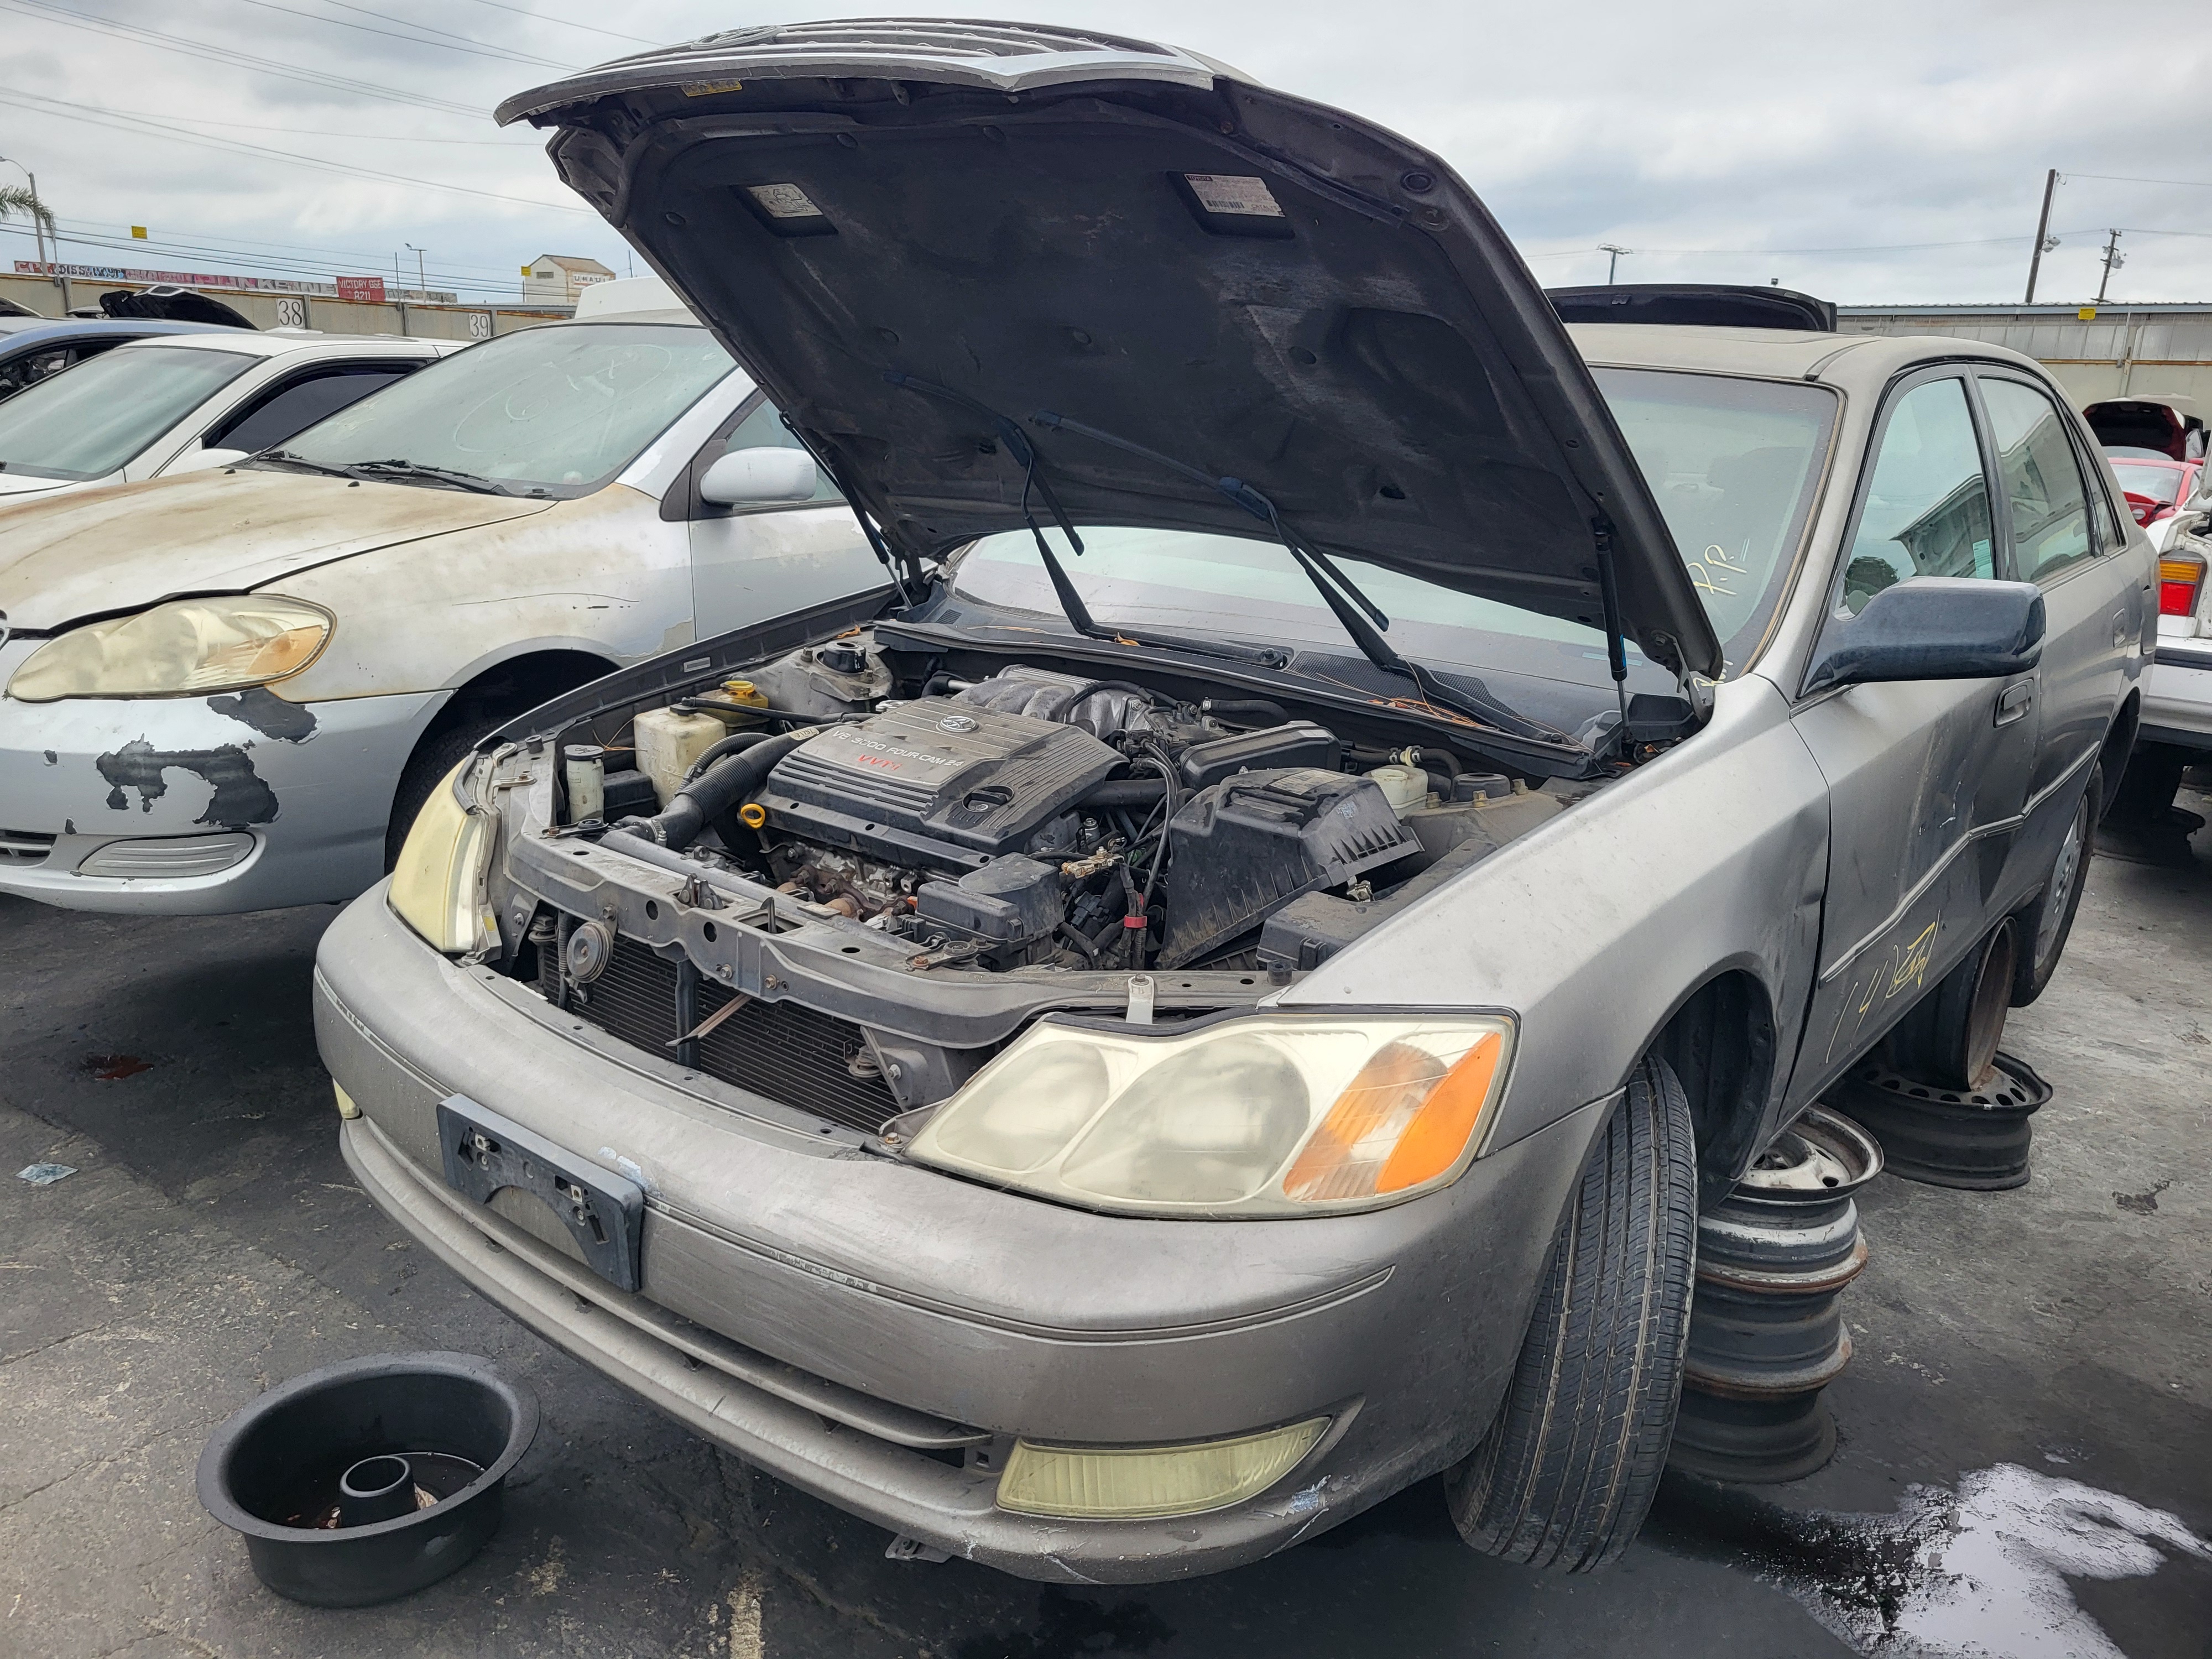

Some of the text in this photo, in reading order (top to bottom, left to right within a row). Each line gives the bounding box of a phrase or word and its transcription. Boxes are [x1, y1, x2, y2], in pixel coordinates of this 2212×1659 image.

[339, 279, 367, 289] VICTORY
[369, 280, 382, 289] GSE
[279, 300, 302, 326] 38
[471, 315, 489, 337] 39
[851, 737, 887, 751] 3000
[886, 747, 920, 759] FOUR
[918, 754, 947, 766] CAM
